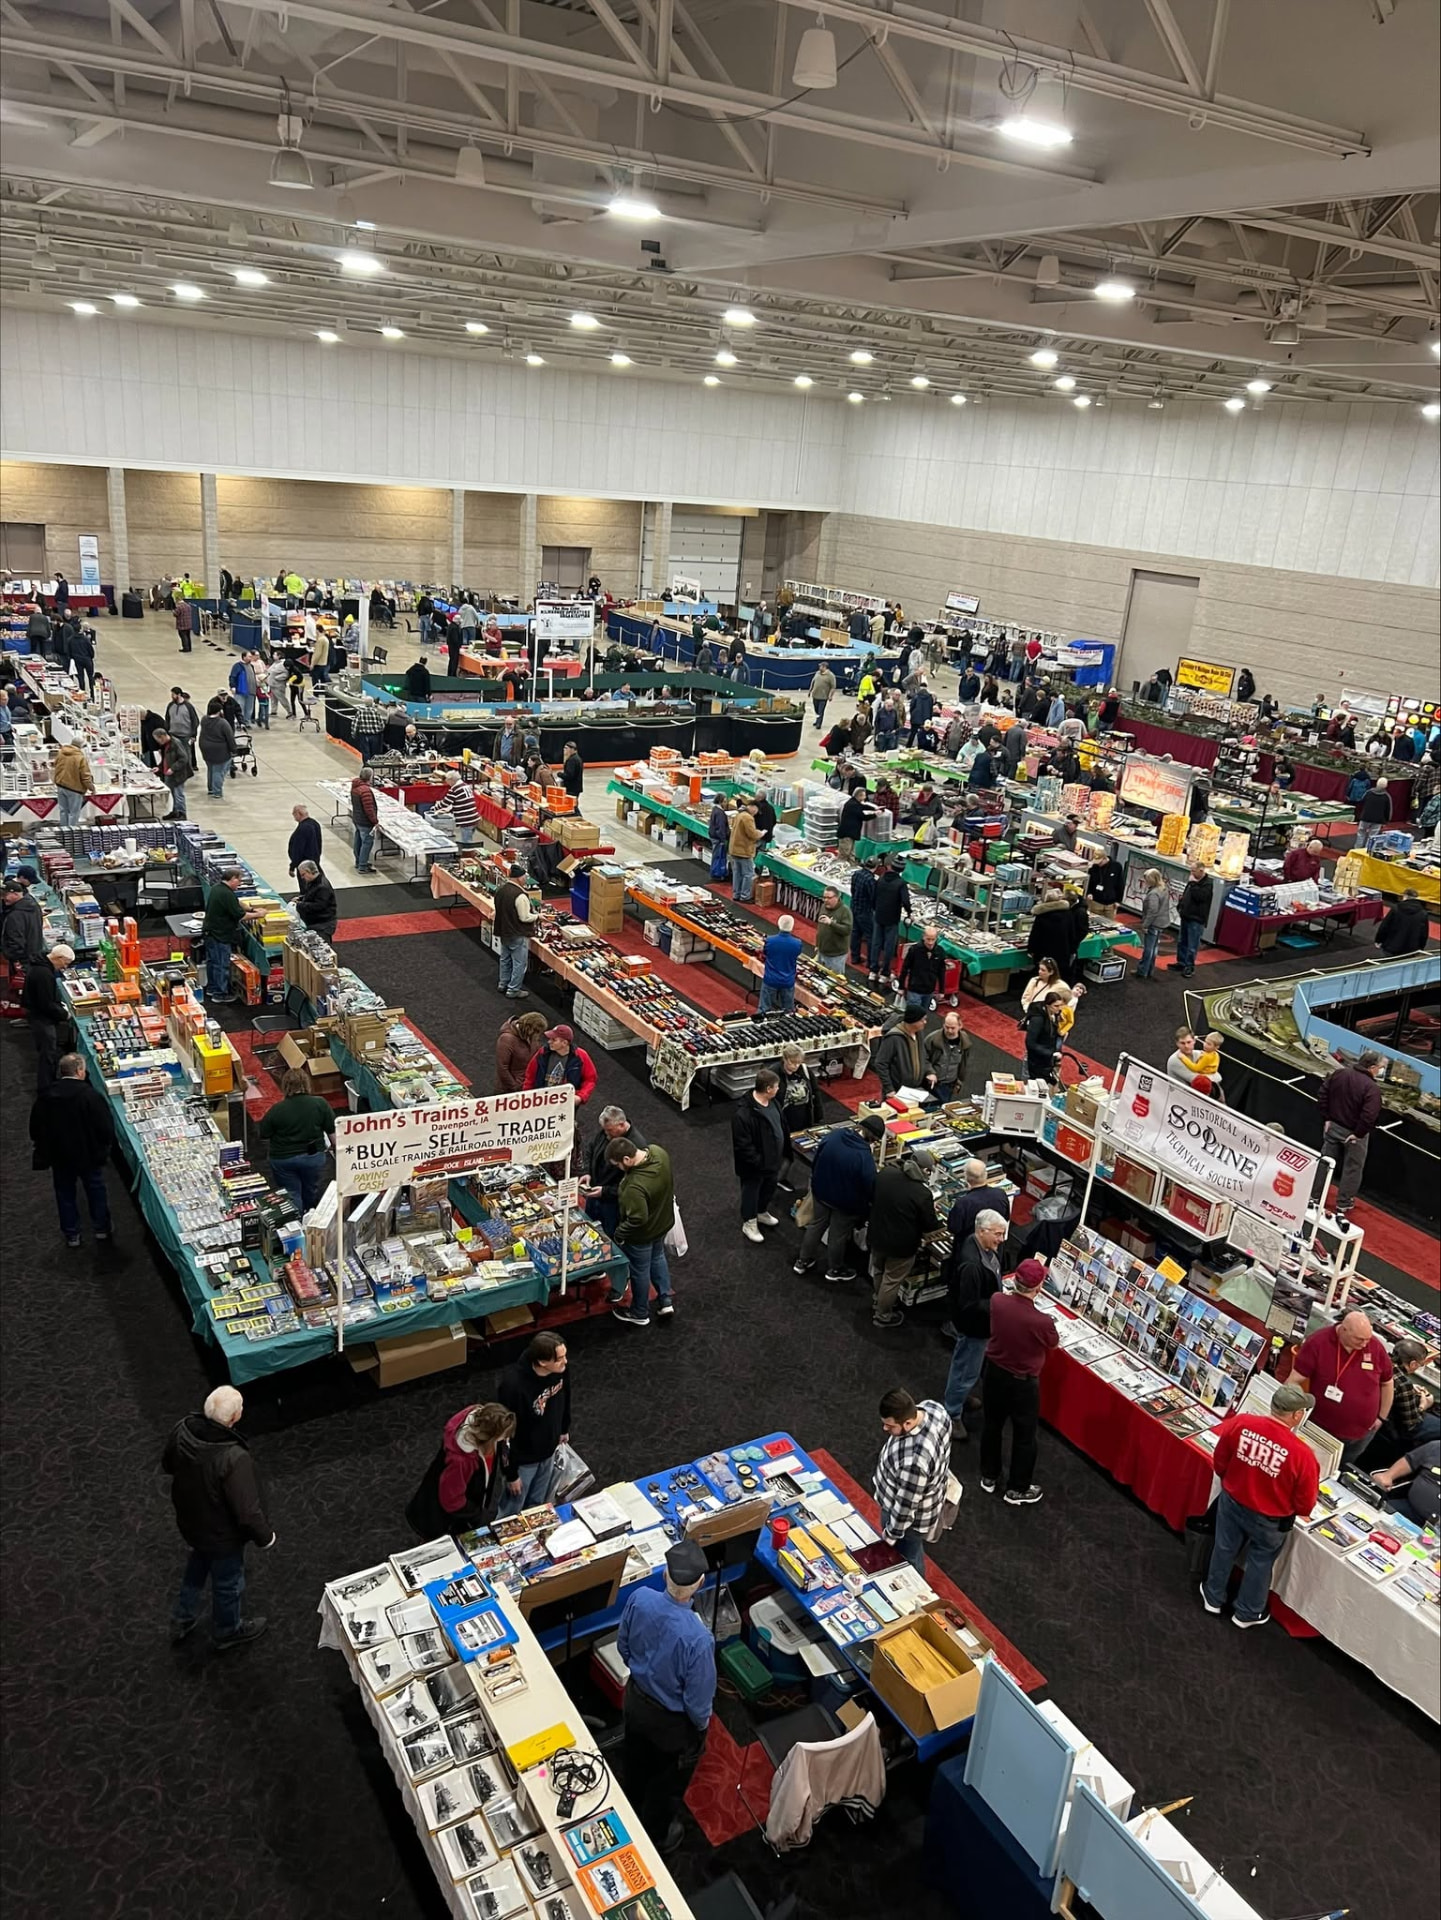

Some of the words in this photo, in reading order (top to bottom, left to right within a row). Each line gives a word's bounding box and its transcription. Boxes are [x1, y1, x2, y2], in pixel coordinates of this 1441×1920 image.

[412, 1105, 469, 1124] Trains
[474, 1100, 489, 1115] &
[495, 1090, 568, 1113] Hobbies
[431, 1119, 478, 1132] Davenport,
[1191, 1105, 1238, 1137] HISTORICAL
[1241, 1135, 1261, 1154] AND
[350, 1161, 368, 1171] ALL
[370, 1156, 399, 1169] SCALE
[402, 1150, 436, 1162] TRAINS
[438, 1148, 446, 1156] &
[448, 1141, 495, 1154] RAILROAD
[496, 1130, 562, 1146] MEMORABILIA
[429, 1131, 469, 1150] SELL
[527, 1141, 560, 1153] PAYING
[531, 1151, 555, 1162] CASH
[1165, 1130, 1205, 1175] TECHNICAL
[1206, 1170, 1244, 1193] SOCIETY
[1201, 1139, 1258, 1181] LINE
[1281, 1150, 1308, 1169] SOO
[353, 1169, 389, 1182] PAYING
[358, 1180, 385, 1192] CASH
[1282, 1211, 1296, 1221] Rail
[1237, 1434, 1286, 1470] FIRE
[1241, 1428, 1288, 1456] CHICAGO
[1237, 1453, 1279, 1478] DEPARTMENT
[619, 1854, 641, 1889] RAILROAD
[624, 1850, 647, 1888] MONTANA
